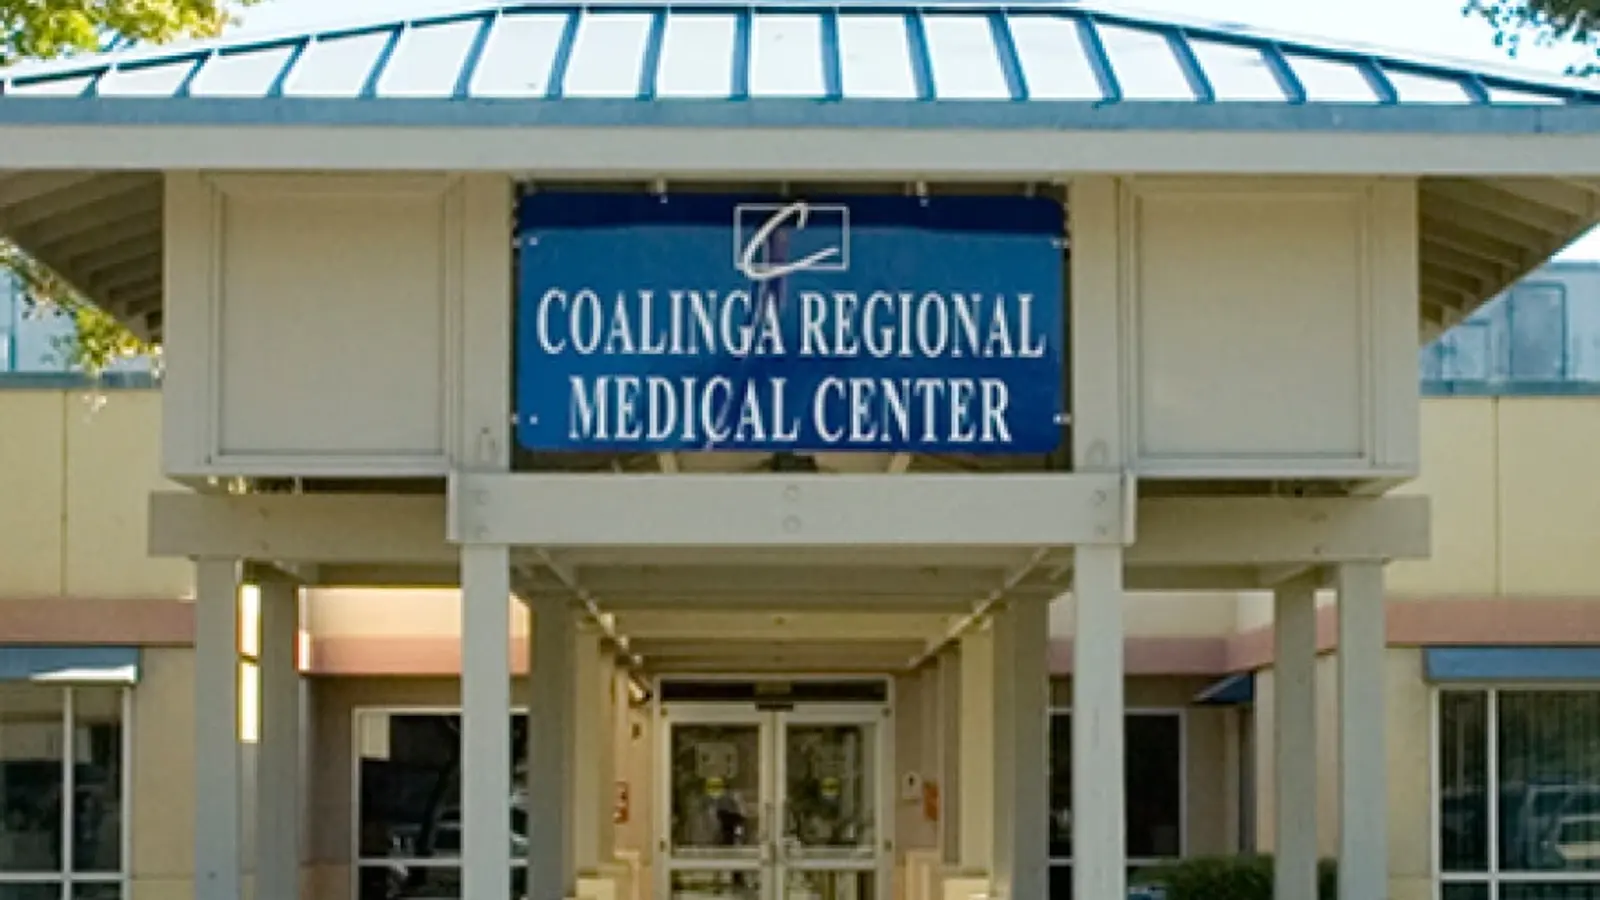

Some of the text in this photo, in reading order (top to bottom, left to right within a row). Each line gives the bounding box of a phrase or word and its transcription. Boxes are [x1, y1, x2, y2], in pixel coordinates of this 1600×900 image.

[536, 287, 1045, 359] COALINGA REGIONAL
[568, 376, 1012, 443] MEDICAL CENTER
